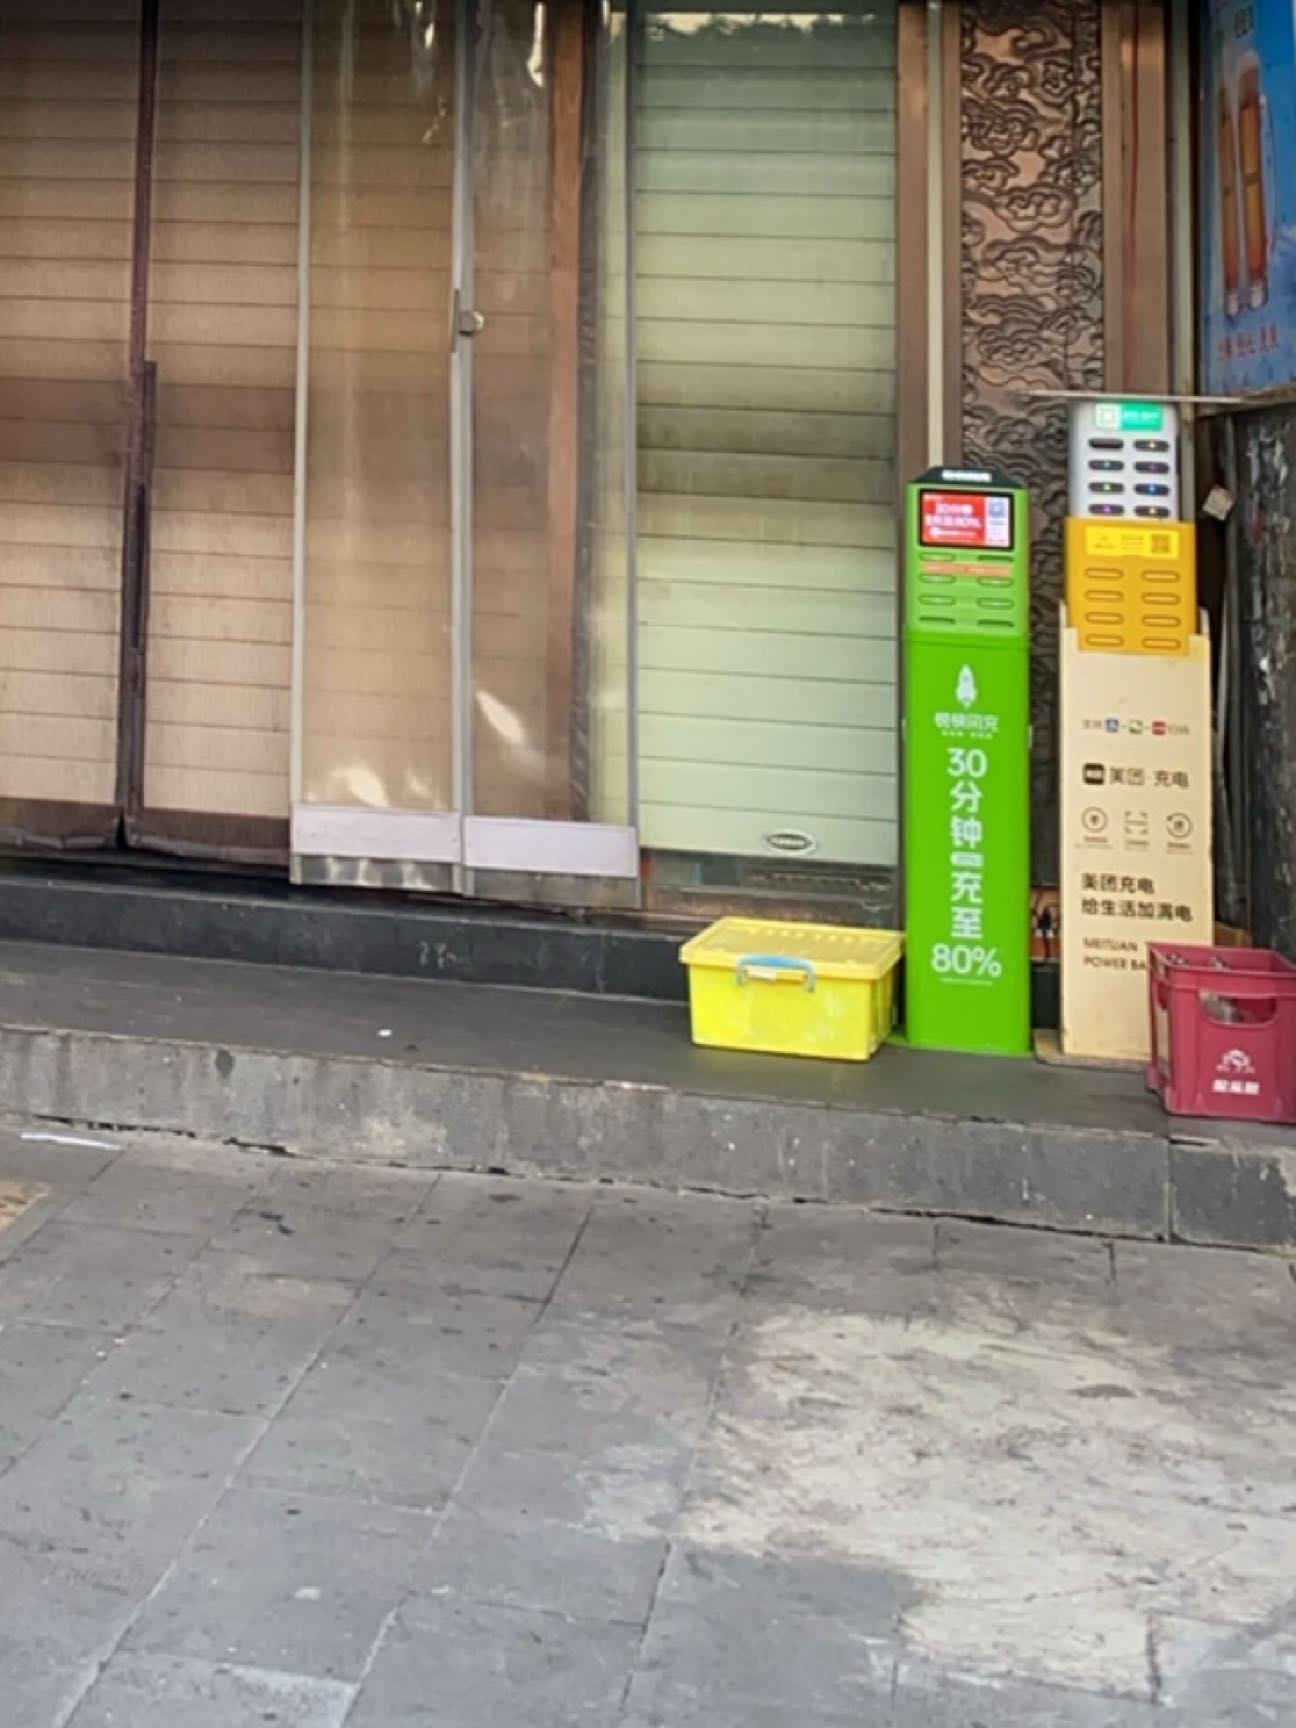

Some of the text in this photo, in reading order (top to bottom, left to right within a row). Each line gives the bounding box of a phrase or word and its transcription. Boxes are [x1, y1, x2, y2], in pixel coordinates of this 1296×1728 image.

[1081, 872, 1154, 894] 美团充电
[1083, 956, 1127, 969] POWER
